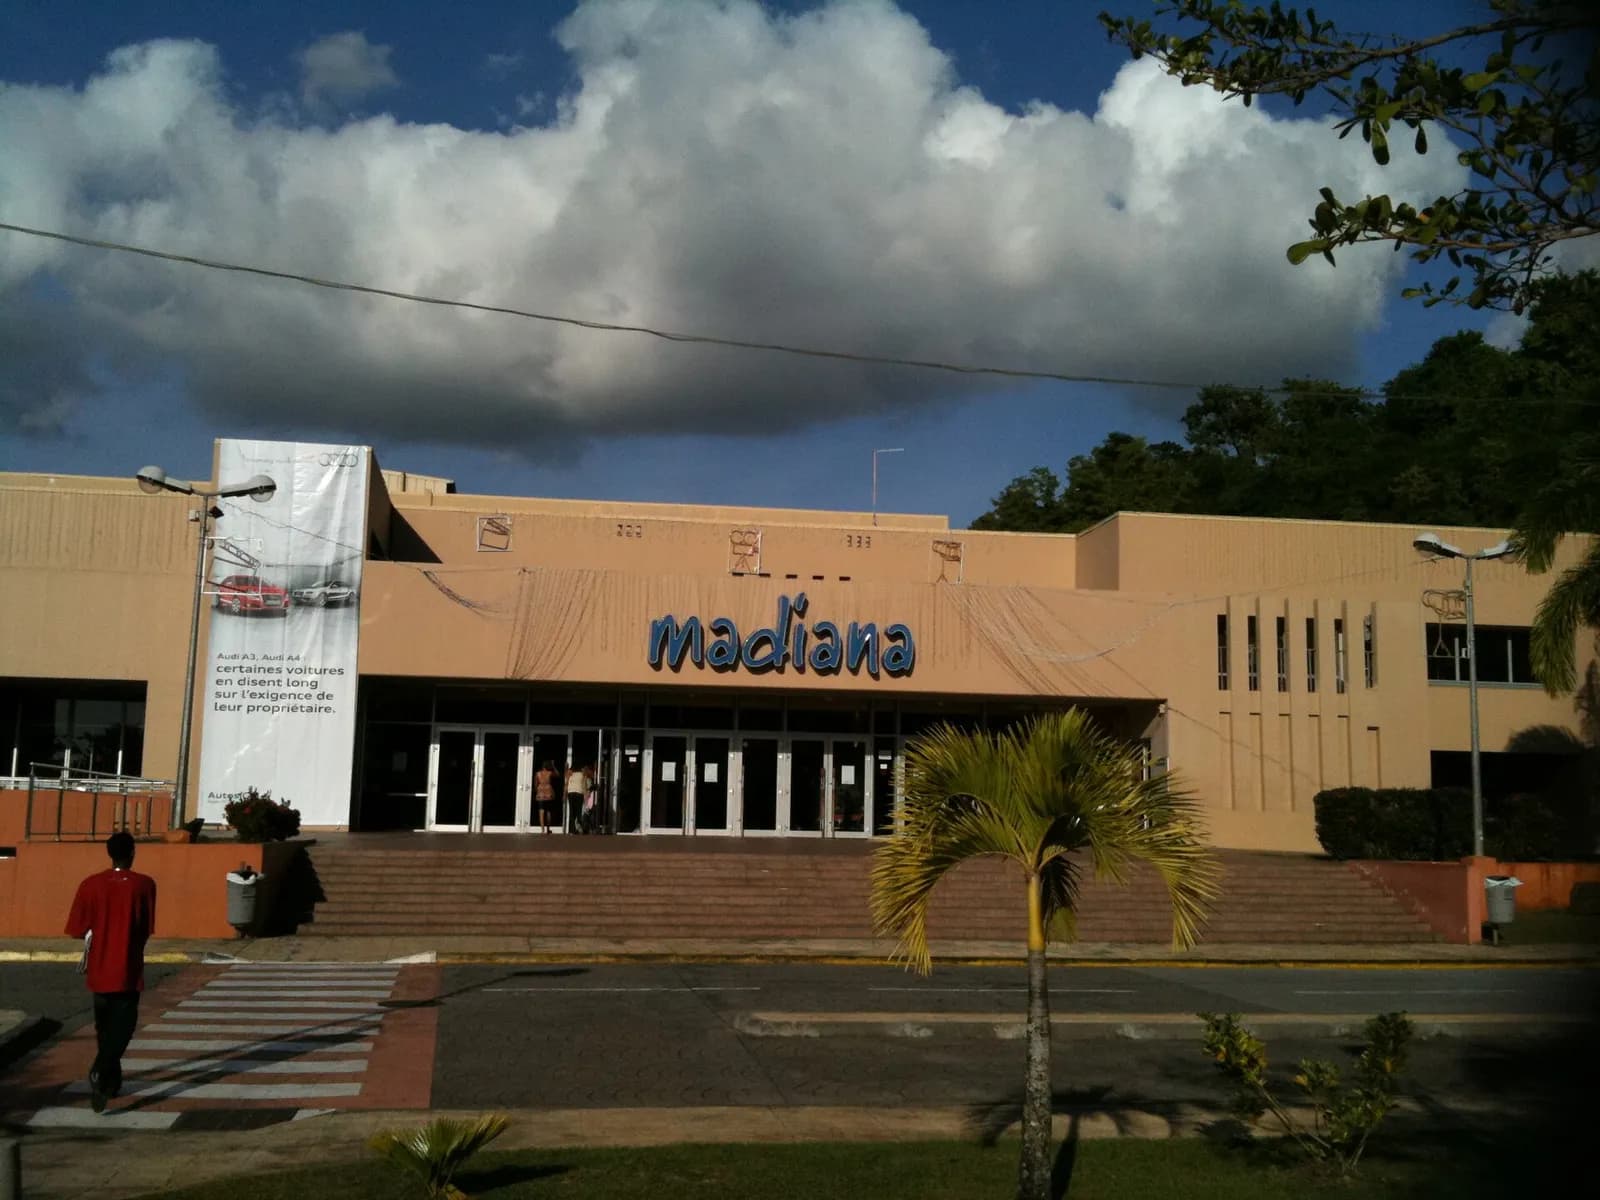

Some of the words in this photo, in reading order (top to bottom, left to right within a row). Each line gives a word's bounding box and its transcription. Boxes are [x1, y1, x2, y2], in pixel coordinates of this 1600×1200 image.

[648, 592, 915, 678] madiana
[216, 652, 240, 661] Audi
[262, 653, 285, 662] Audi
[216, 664, 283, 675] certaines
[286, 665, 345, 676] voitures
[215, 678, 233, 686] en
[237, 677, 283, 688] disent
[286, 678, 319, 689] long
[214, 691, 238, 699] sur
[316, 691, 334, 701] de
[214, 702, 243, 712] leur
[246, 702, 337, 715] propriétaire.
